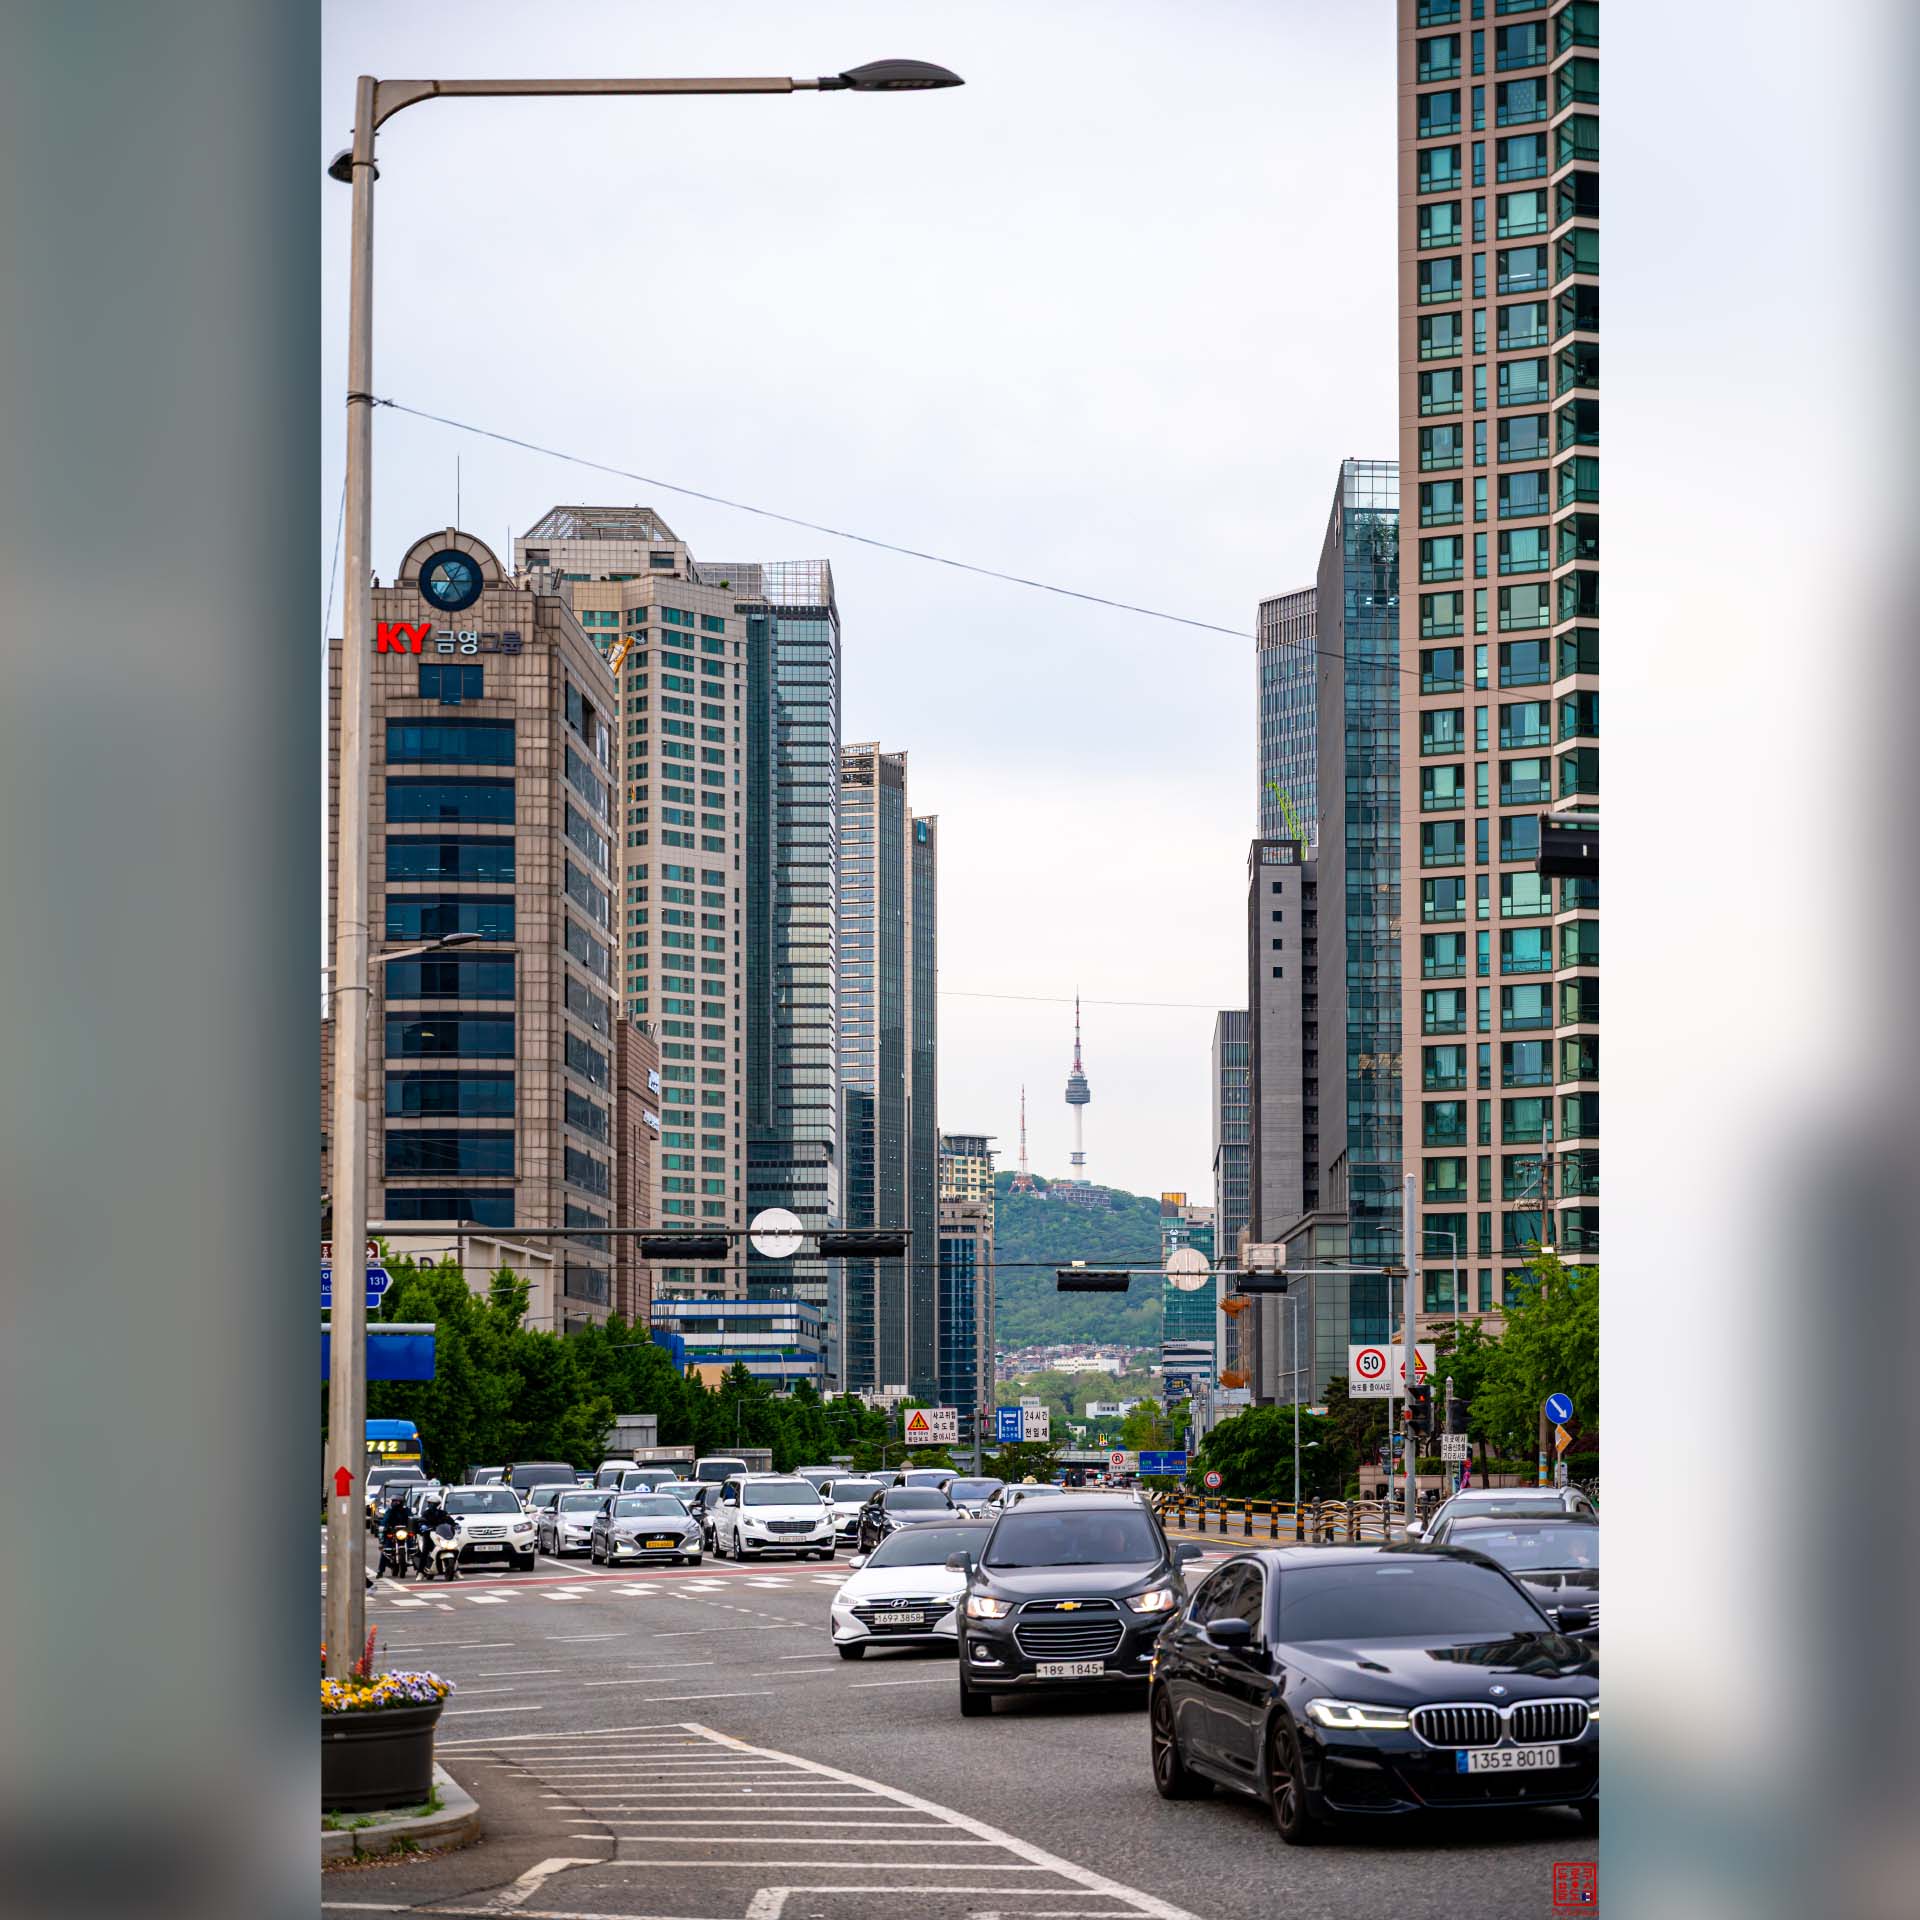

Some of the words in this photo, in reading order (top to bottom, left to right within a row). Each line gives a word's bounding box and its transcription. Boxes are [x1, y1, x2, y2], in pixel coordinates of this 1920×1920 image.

[376, 622, 432, 654] KY
[435, 630, 521, 655] 금영그룹
[369, 1276, 385, 1286] 131
[1363, 1355, 1379, 1370] 50
[1351, 1383, 1367, 1392] 속도를
[1369, 1383, 1391, 1392] 줄이시오
[1025, 1410, 1048, 1421] 24시간
[933, 1421, 955, 1431] 속도를
[932, 1432, 956, 1441] 줄이시오
[1025, 1427, 1048, 1438] 전일제
[366, 1440, 398, 1453] 742
[1071, 1664, 1099, 1674] 1845
[1471, 1751, 1513, 1769] 135모
[1517, 1749, 1555, 1767] 8010
